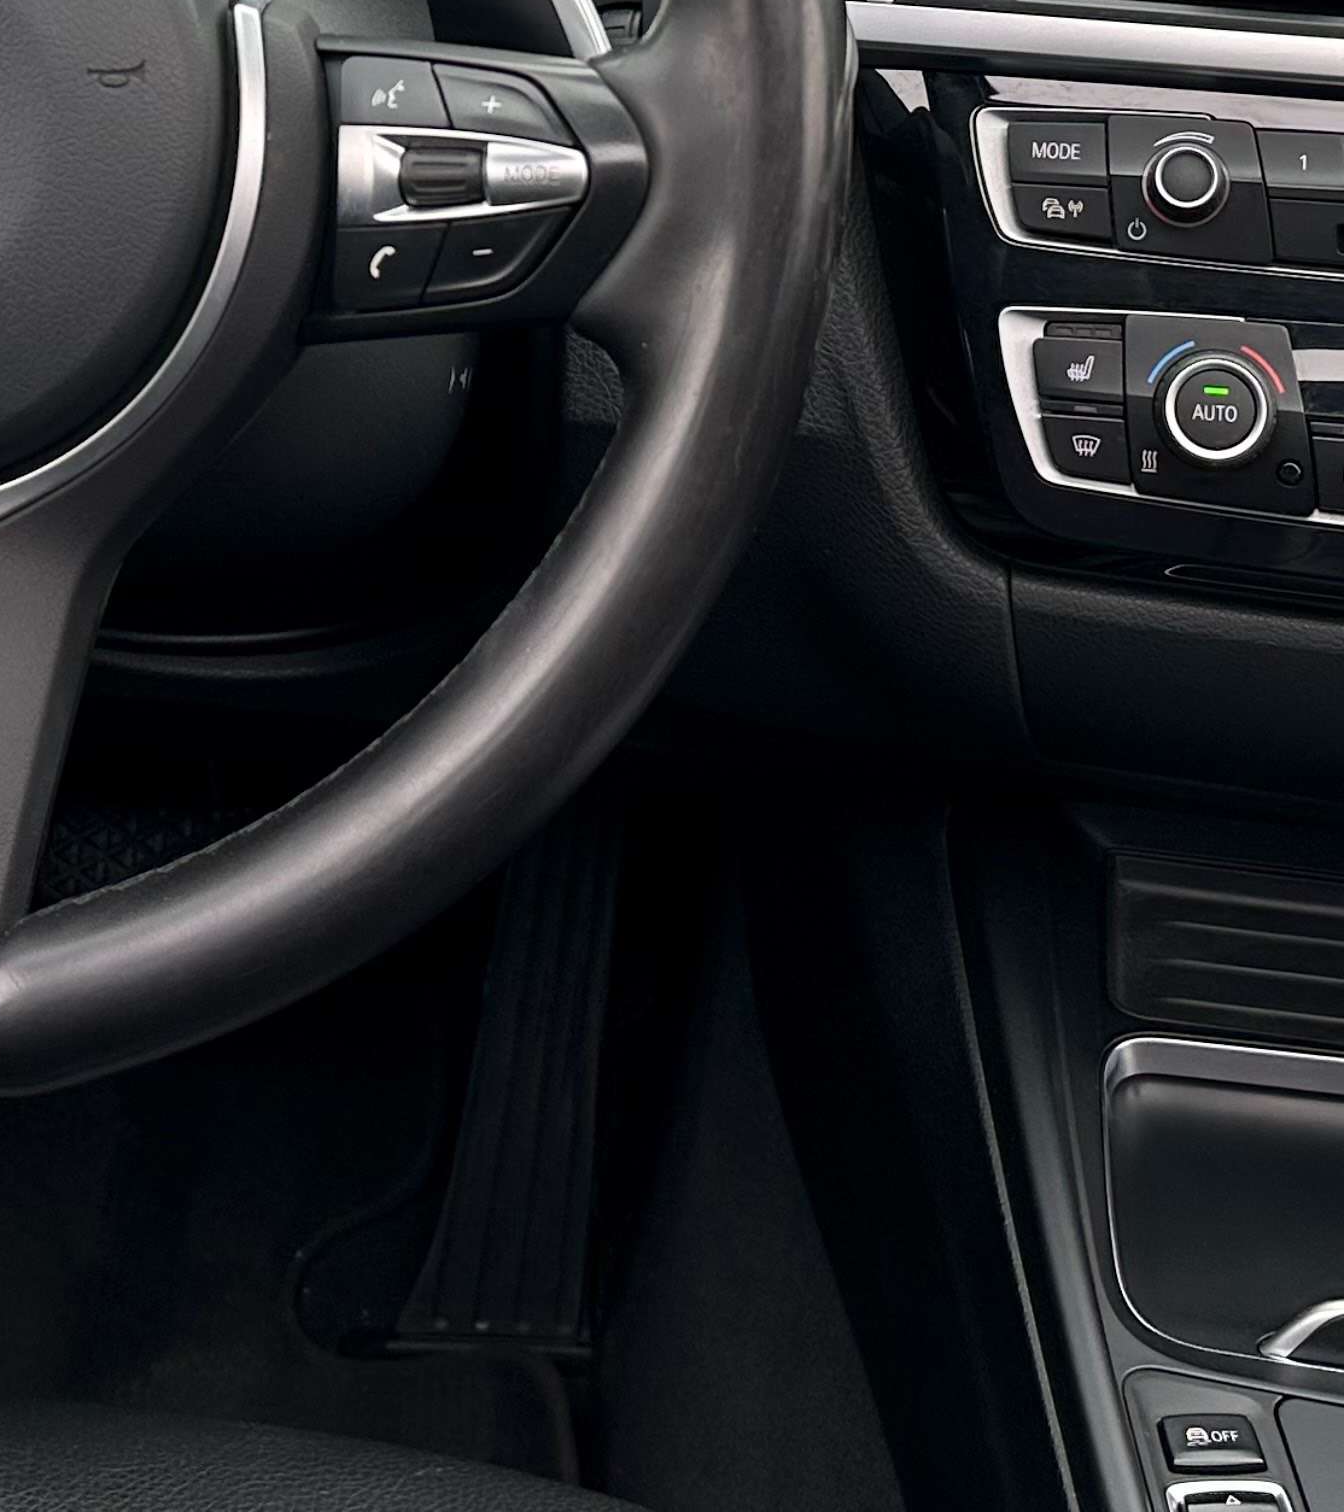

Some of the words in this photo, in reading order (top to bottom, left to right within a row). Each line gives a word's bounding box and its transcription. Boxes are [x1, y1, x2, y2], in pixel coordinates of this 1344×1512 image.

[1031, 141, 1082, 161] MODE
[1298, 153, 1309, 171] 1
[1191, 403, 1239, 424] AUTO
[1210, 1429, 1240, 1443] OFF
